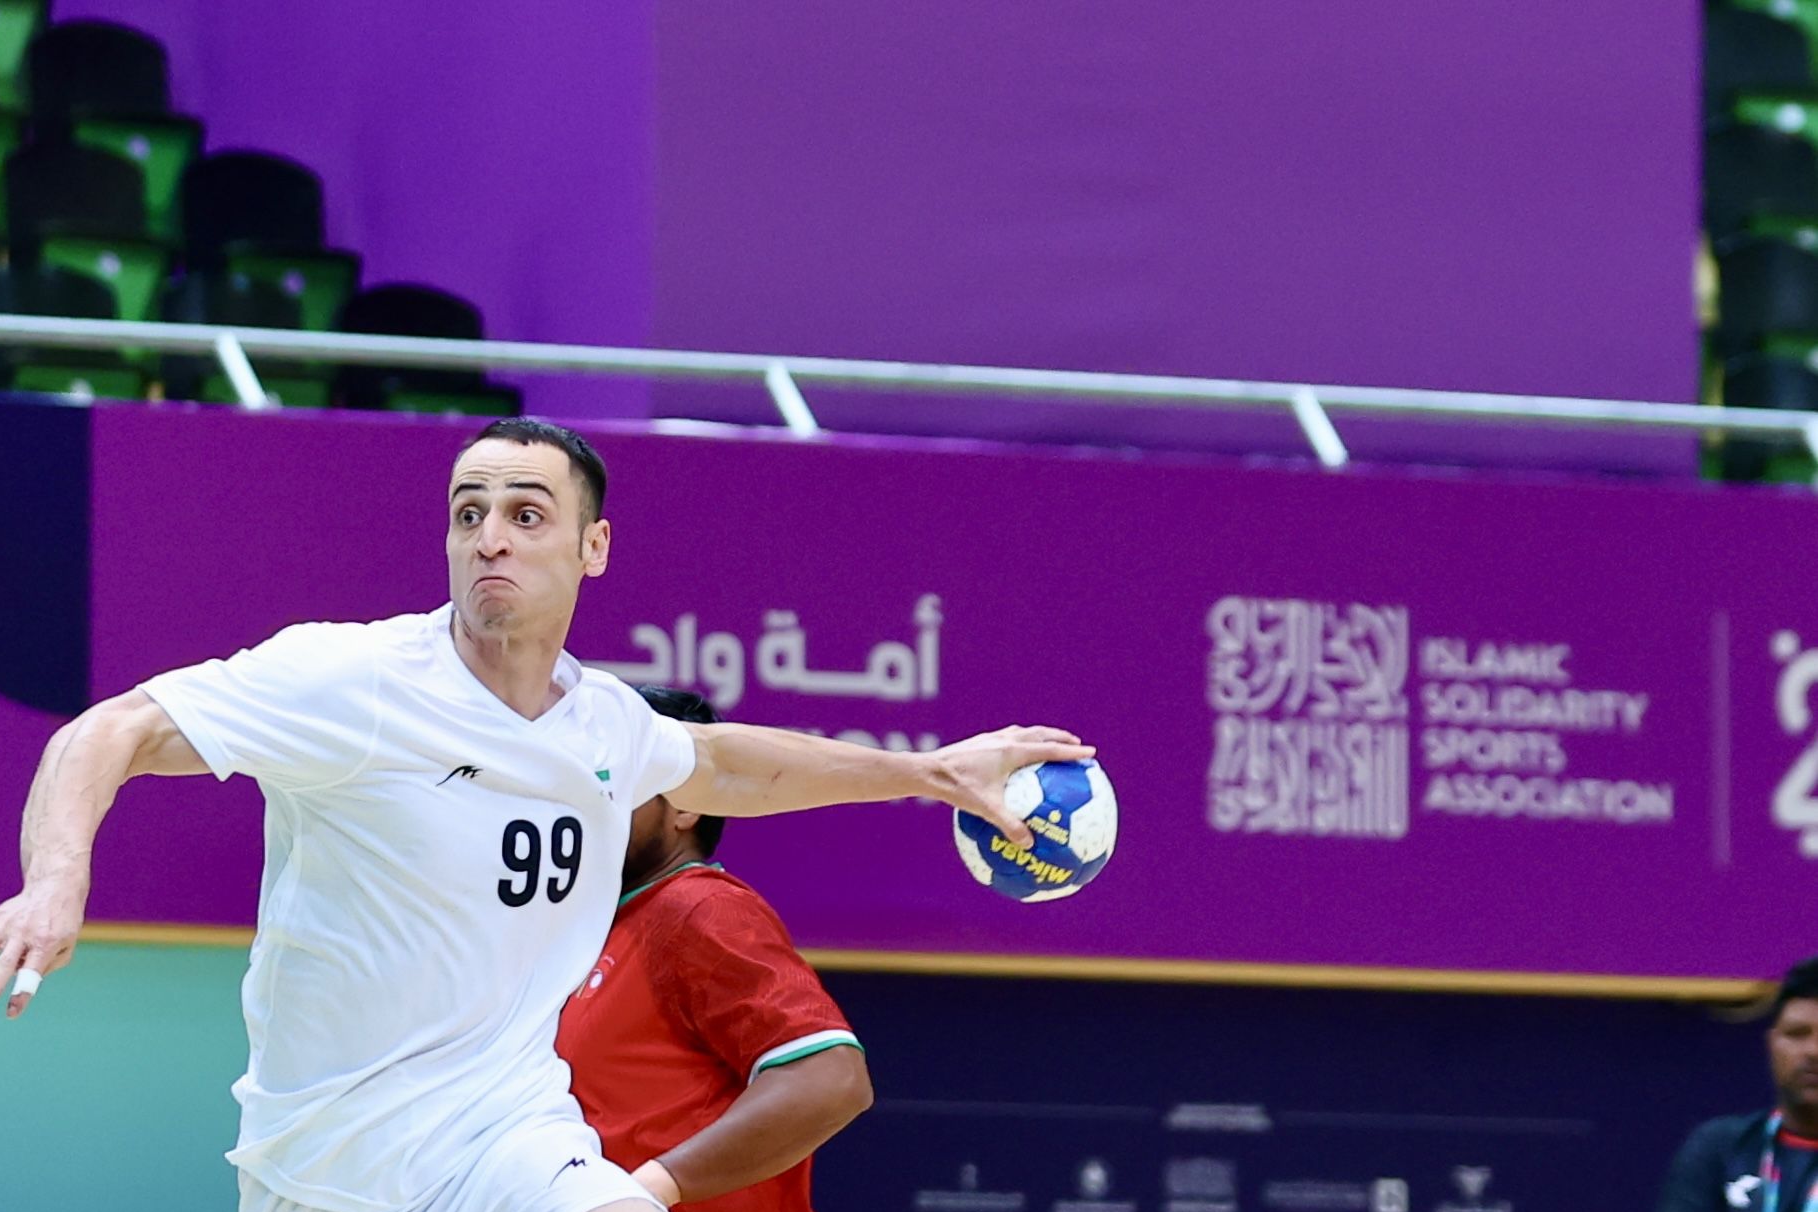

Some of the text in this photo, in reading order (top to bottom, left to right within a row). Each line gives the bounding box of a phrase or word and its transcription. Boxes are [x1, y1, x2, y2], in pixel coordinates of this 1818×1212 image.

[1420, 636, 1570, 684] ISLAMIC
[1420, 682, 1649, 734] SOLIDARITY
[1422, 727, 1566, 774] SPORTS
[1422, 773, 1674, 823] ASSOCIATION
[498, 815, 583, 908] 99
